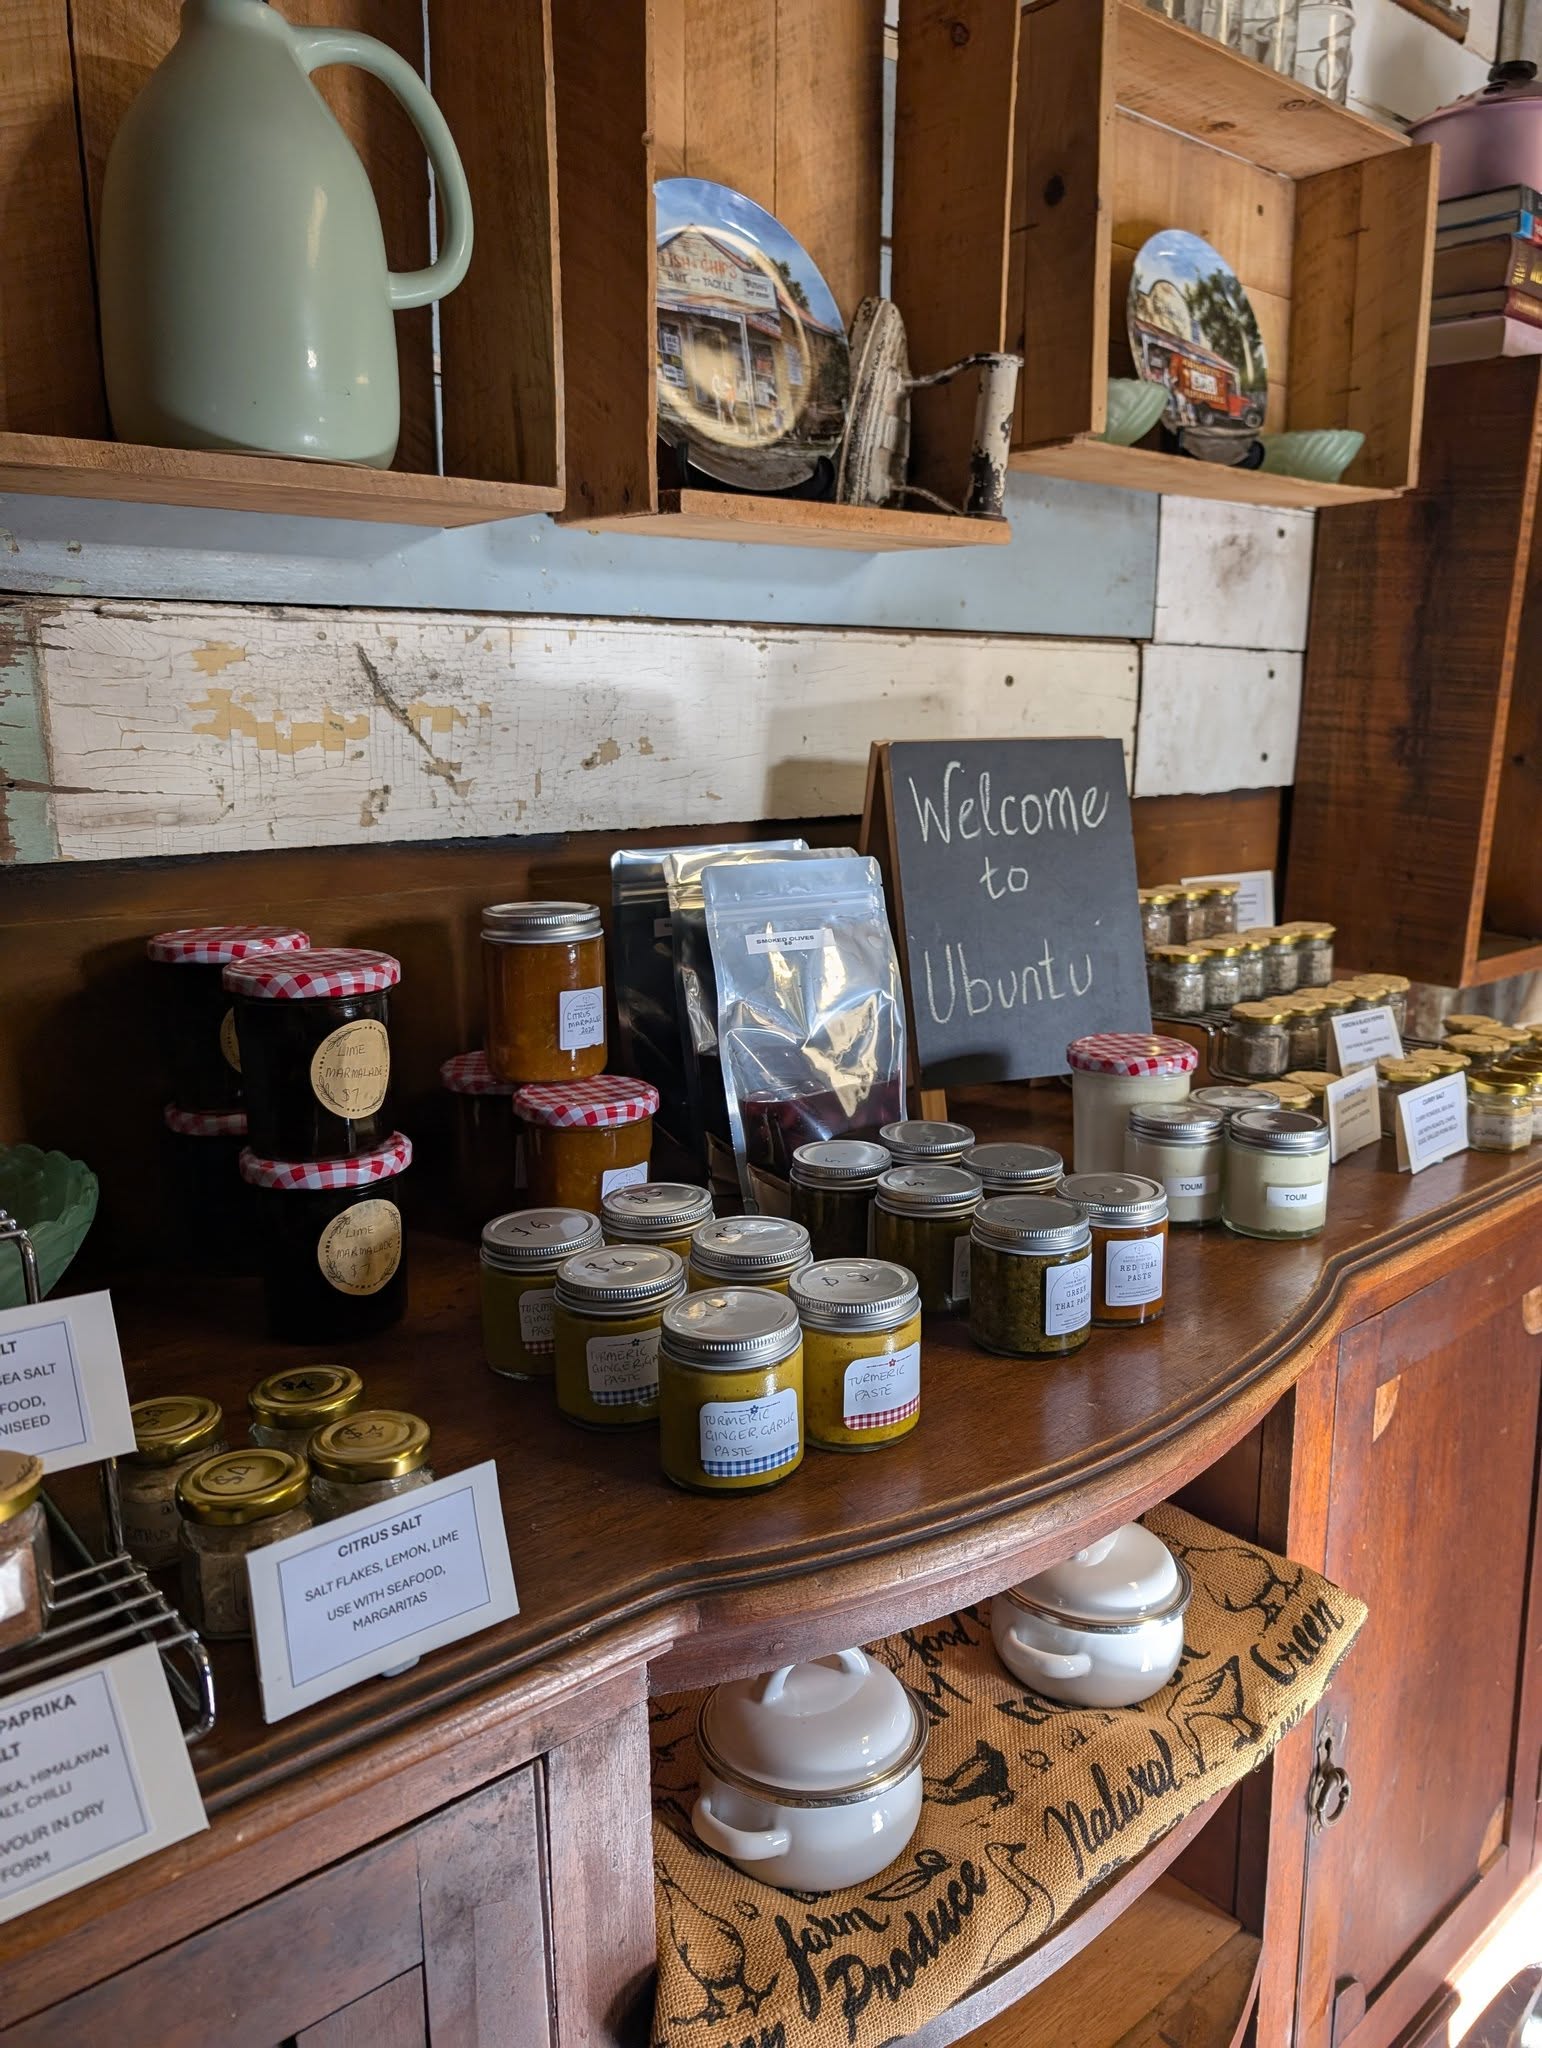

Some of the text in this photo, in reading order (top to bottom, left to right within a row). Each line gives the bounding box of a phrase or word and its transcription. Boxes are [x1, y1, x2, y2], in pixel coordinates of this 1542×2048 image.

[908, 760, 1109, 843] Welcome
[979, 856, 1029, 900] to
[756, 934, 814, 944] SMOKED OLIVES
[924, 938, 1093, 1024] Ubuntu
[567, 1010, 591, 1021] CITRUS
[337, 1044, 366, 1057] LIME
[325, 1065, 382, 1079] MARMALADE
[1180, 1183, 1203, 1191] TOUM
[1285, 1193, 1307, 1201] TOUM
[345, 1225, 374, 1239] LIME
[336, 1240, 393, 1260] MARMALADE
[1120, 1261, 1158, 1273] RED THAI
[1055, 1300, 1075, 1312] THAI
[0, 1340, 17, 1356] LT
[590, 1346, 647, 1363] TURMERIC
[23, 1363, 57, 1381] SALT
[604, 1374, 641, 1386] PASTE
[848, 1364, 905, 1387] TURMERIC
[854, 1383, 893, 1402] PASTE
[703, 1408, 770, 1427] TURMERIC
[760, 1411, 795, 1436] GARLIC
[714, 1445, 754, 1457] PASTE
[338, 1514, 423, 1558] CITRUS SALT
[305, 1530, 460, 1603] SALT FLAKES, LEMON, LIME
[327, 1564, 447, 1622] USE WITH SEAFOOD,
[352, 1591, 428, 1632] MARGARITAS
[1250, 1598, 1345, 1687] Green
[0, 1693, 77, 1732] PAPRIKA
[30, 1743, 111, 1784] HIMALAYAN
[26, 1780, 73, 1811] CHILLI
[1043, 1729, 1183, 1880] Natural
[52, 1815, 71, 1835] IN
[72, 1800, 106, 1826] DRY
[0, 1850, 52, 1884] FORM
[774, 1905, 890, 2023] farm
[824, 1860, 988, 2045] Produce
